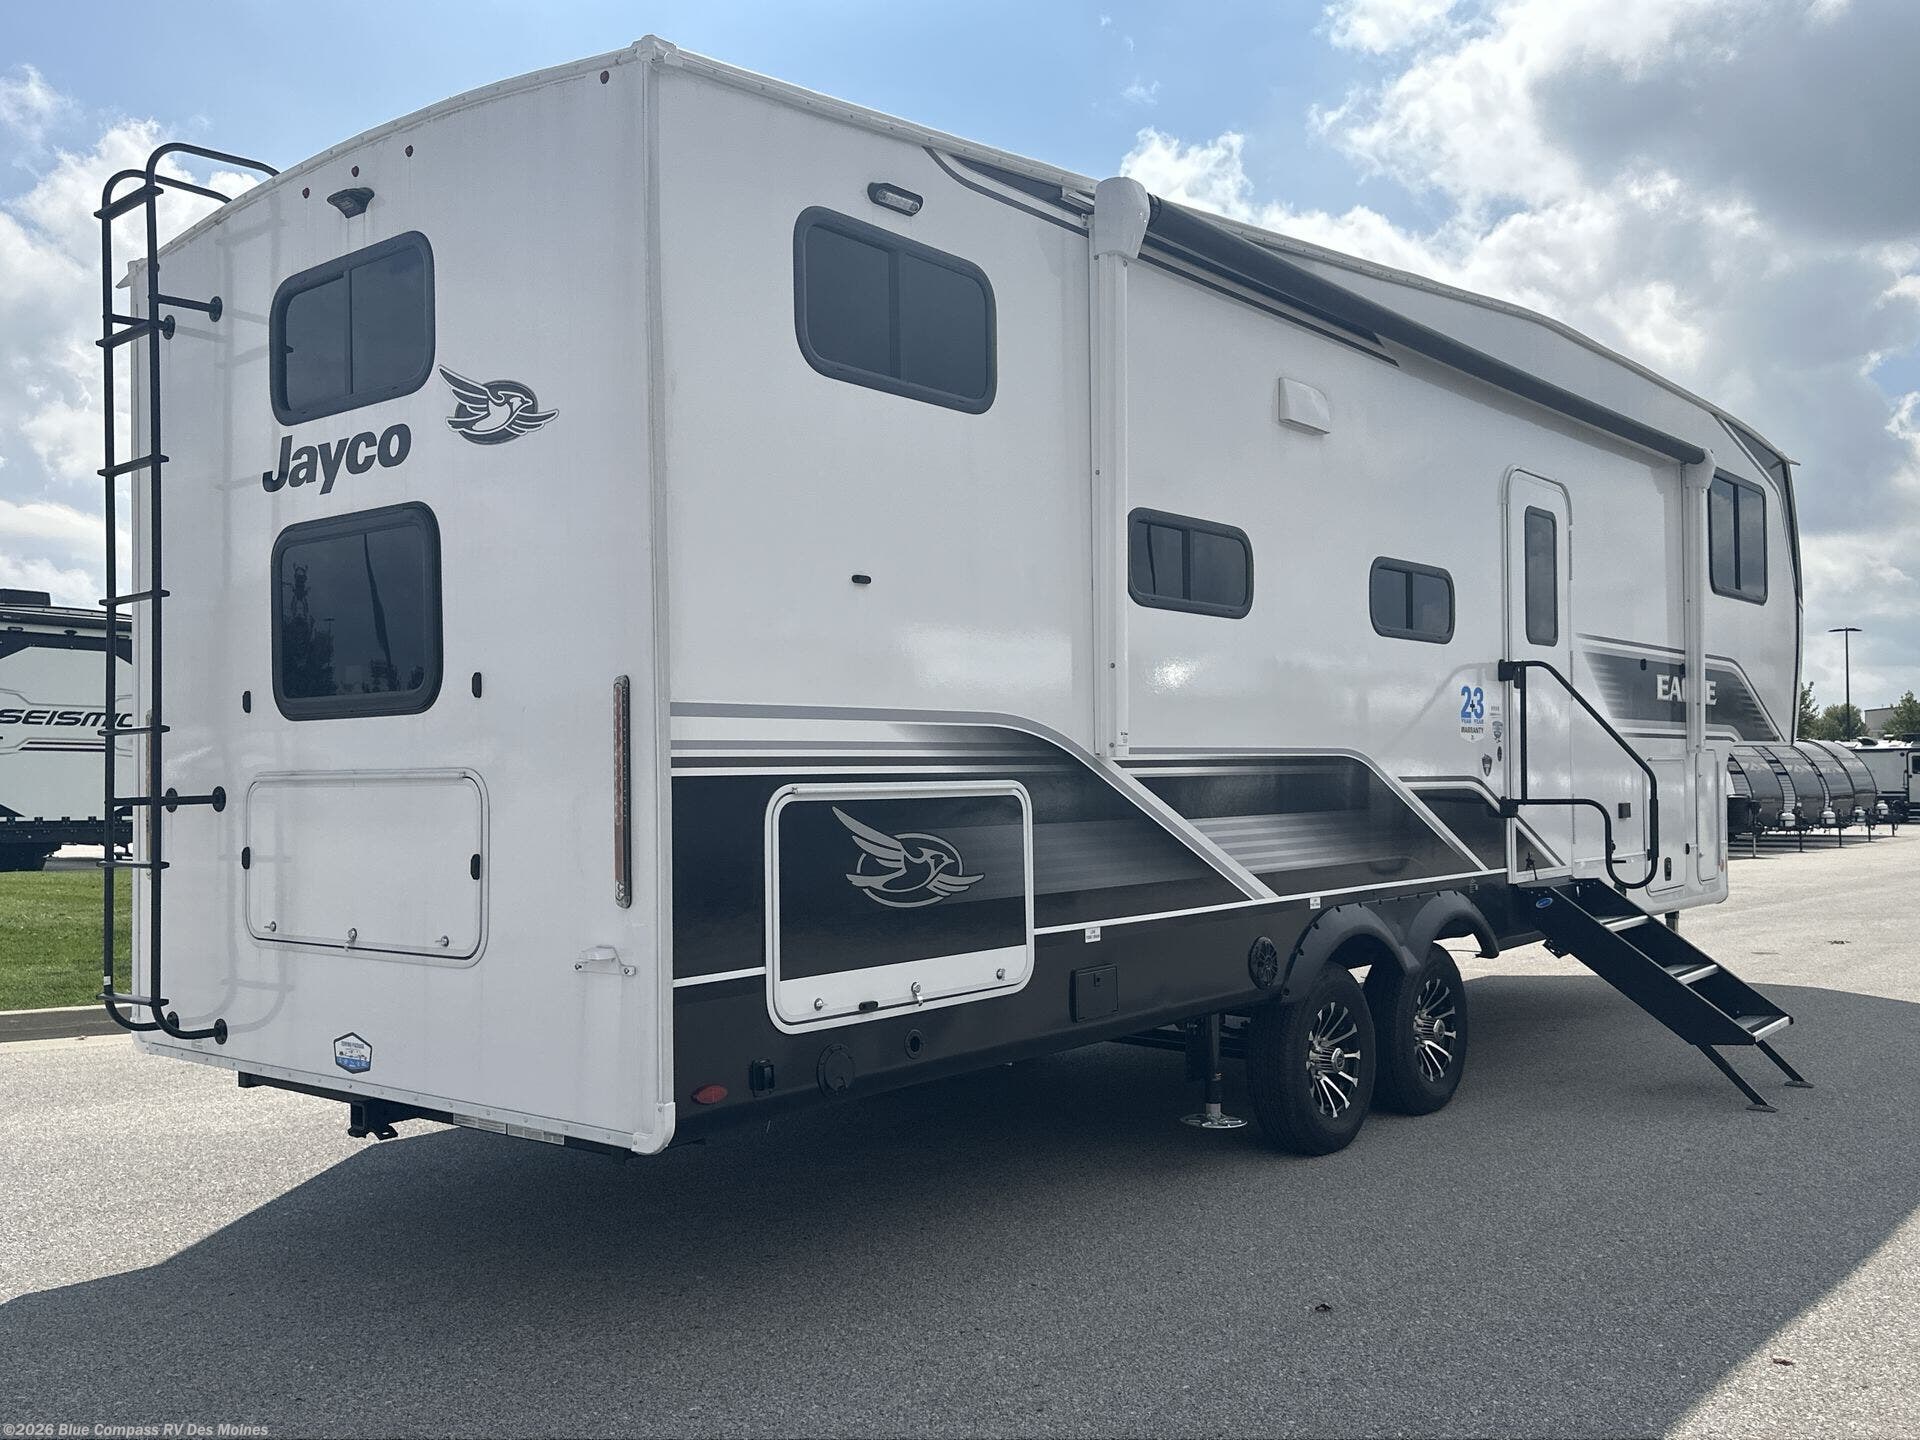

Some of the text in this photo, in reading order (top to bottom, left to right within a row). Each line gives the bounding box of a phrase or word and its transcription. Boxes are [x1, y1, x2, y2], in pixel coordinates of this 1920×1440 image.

[262, 423, 412, 495] Jayco
[1656, 674, 1717, 705] EAE
[1461, 726, 1484, 734] WARRANTY
